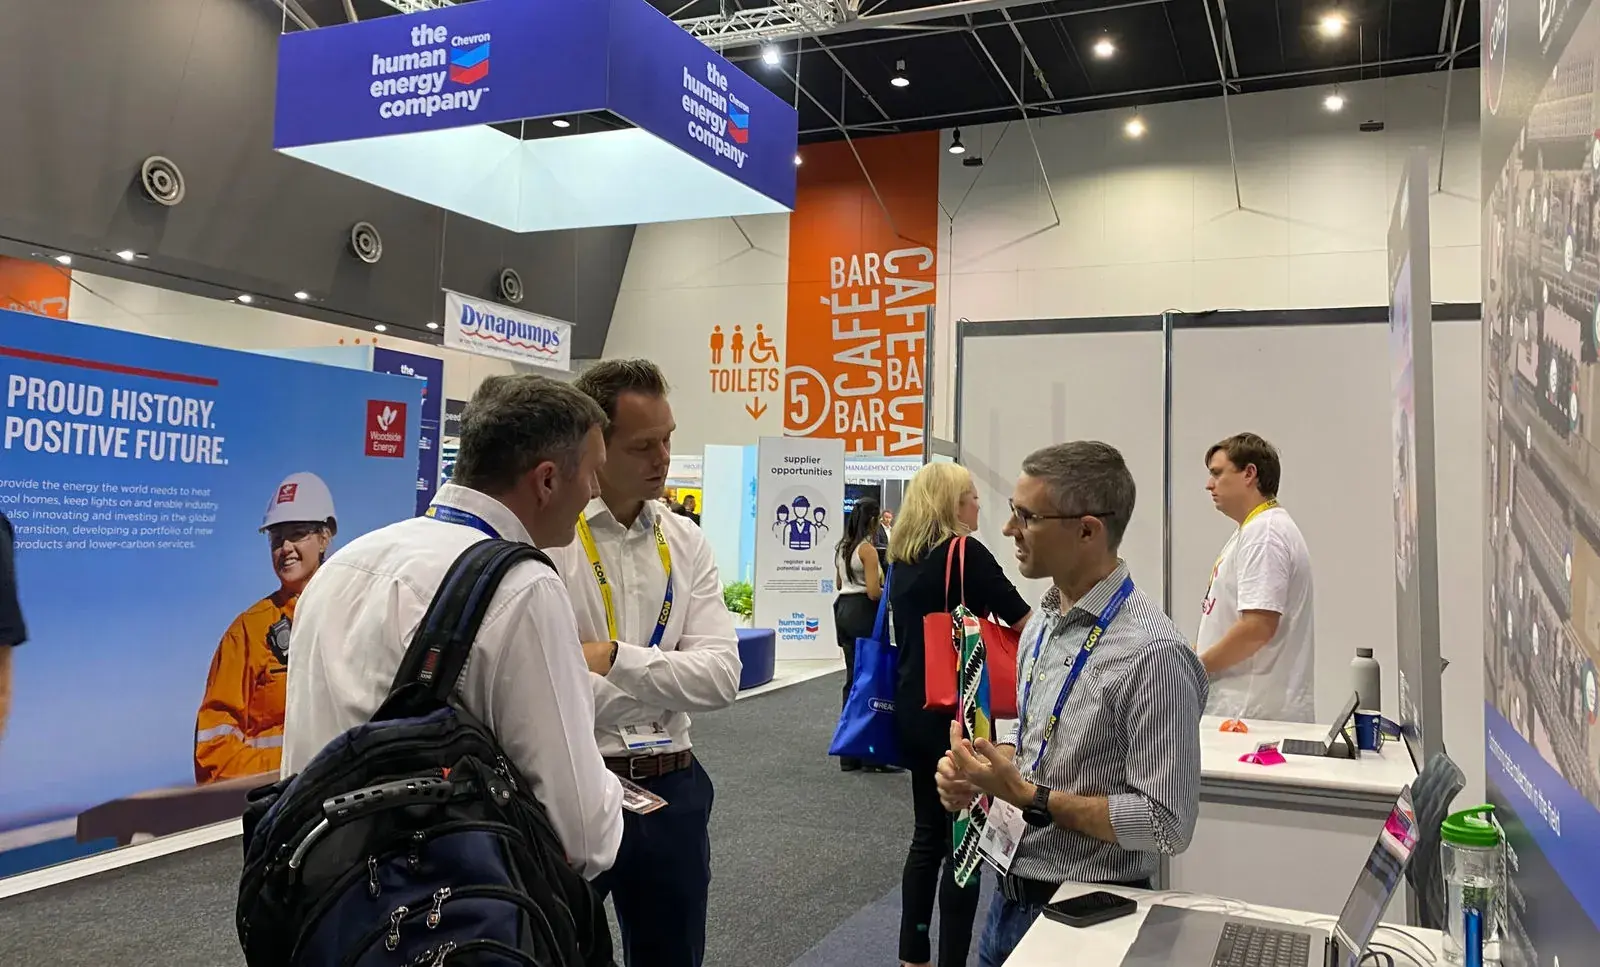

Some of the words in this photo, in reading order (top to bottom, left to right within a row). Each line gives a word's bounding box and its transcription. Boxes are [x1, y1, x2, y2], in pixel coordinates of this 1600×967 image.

[411, 24, 447, 47] the
[451, 33, 490, 46] Chevron
[372, 48, 446, 75] human
[370, 71, 446, 97] energy
[707, 62, 727, 91] the
[683, 66, 727, 113] human
[682, 94, 727, 136] energy
[831, 252, 881, 289] BAR
[461, 304, 560, 347] Dynapumps
[820, 288, 882, 397] CAFÉ
[400, 364, 415, 376] the
[709, 368, 780, 393] TOILETS
[887, 356, 923, 391] BA
[7, 374, 104, 417] PROUD
[110, 388, 216, 429] HISTORY.
[790, 378, 809, 424] 5
[835, 398, 885, 433] BAR
[4, 416, 130, 459] POSITIVE
[135, 429, 229, 465] FUTURE.
[370, 430, 402, 442] Woodside
[373, 441, 397, 454] Energy
[783, 455, 821, 464] supplier
[846, 464, 888, 472] MANAGEMENT
[890, 464, 920, 472] CONTRO
[771, 466, 833, 477] opportunities
[42, 480, 60, 490] the
[63, 483, 99, 493] energy
[102, 483, 119, 493] the
[121, 485, 149, 494] world
[150, 487, 178, 496] needs
[180, 487, 190, 496] to
[64, 496, 89, 507] keep
[91, 497, 118, 508] lights
[134, 500, 152, 508] and
[7, 509, 29, 519] also
[32, 510, 90, 522] innovating
[92, 511, 112, 521] and
[114, 512, 158, 523] investing
[160, 513, 169, 521] in
[171, 514, 187, 522] the
[188, 514, 216, 524] global
[72, 526, 129, 537] developing
[140, 527, 181, 537] portfolio
[183, 527, 193, 536] of
[65, 540, 86, 549] and
[593, 561, 607, 585] ICON
[658, 601, 673, 626] ICON
[778, 619, 805, 627] human
[792, 612, 805, 620] the
[778, 627, 805, 635] energy
[781, 633, 817, 641] company
[1084, 625, 1104, 653] ICON
